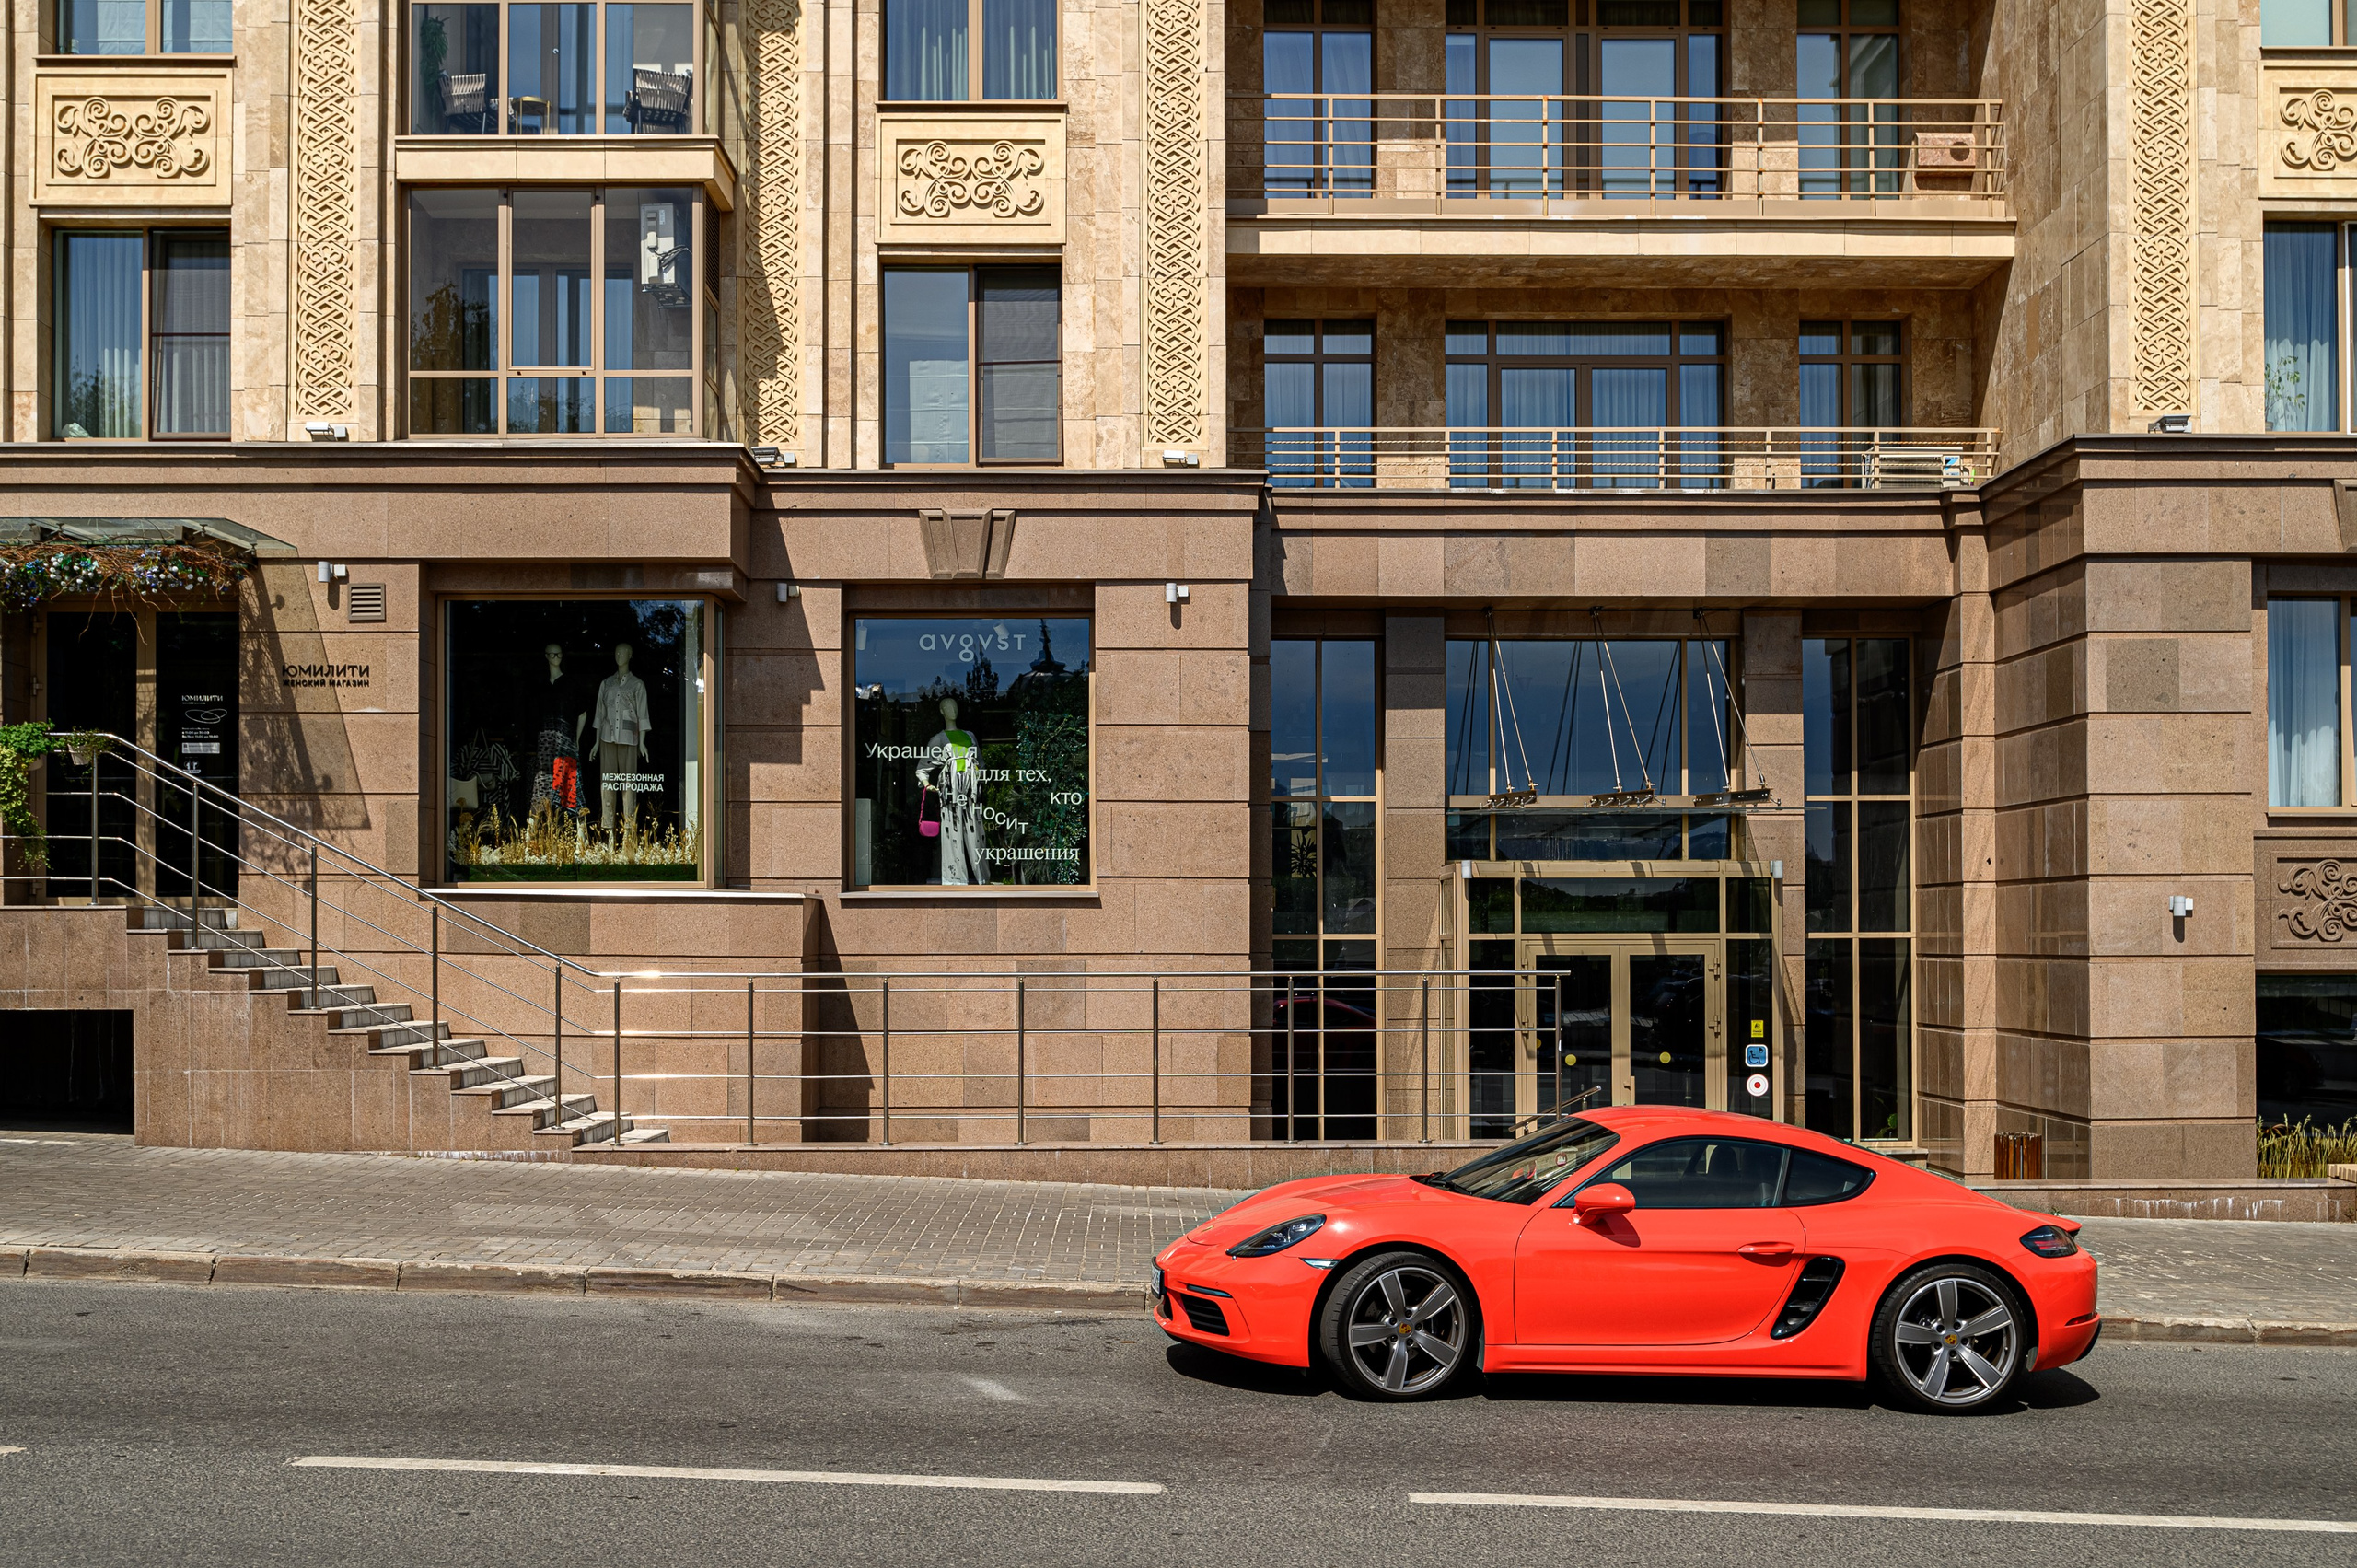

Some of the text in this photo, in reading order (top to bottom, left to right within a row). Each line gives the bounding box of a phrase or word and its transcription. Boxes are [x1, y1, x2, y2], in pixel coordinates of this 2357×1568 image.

[282, 664, 370, 678] ЮМИЛИТИ
[283, 679, 326, 687] ЖЕНСКИЙ
[602, 773, 665, 782] МЕЖСЕЗОННАЯ
[977, 769, 1051, 784] для тех,
[602, 782, 664, 793] РАСПРОДАЖА
[1051, 792, 1082, 805] кто
[972, 802, 1029, 835] носит
[975, 847, 1080, 865] украшения
